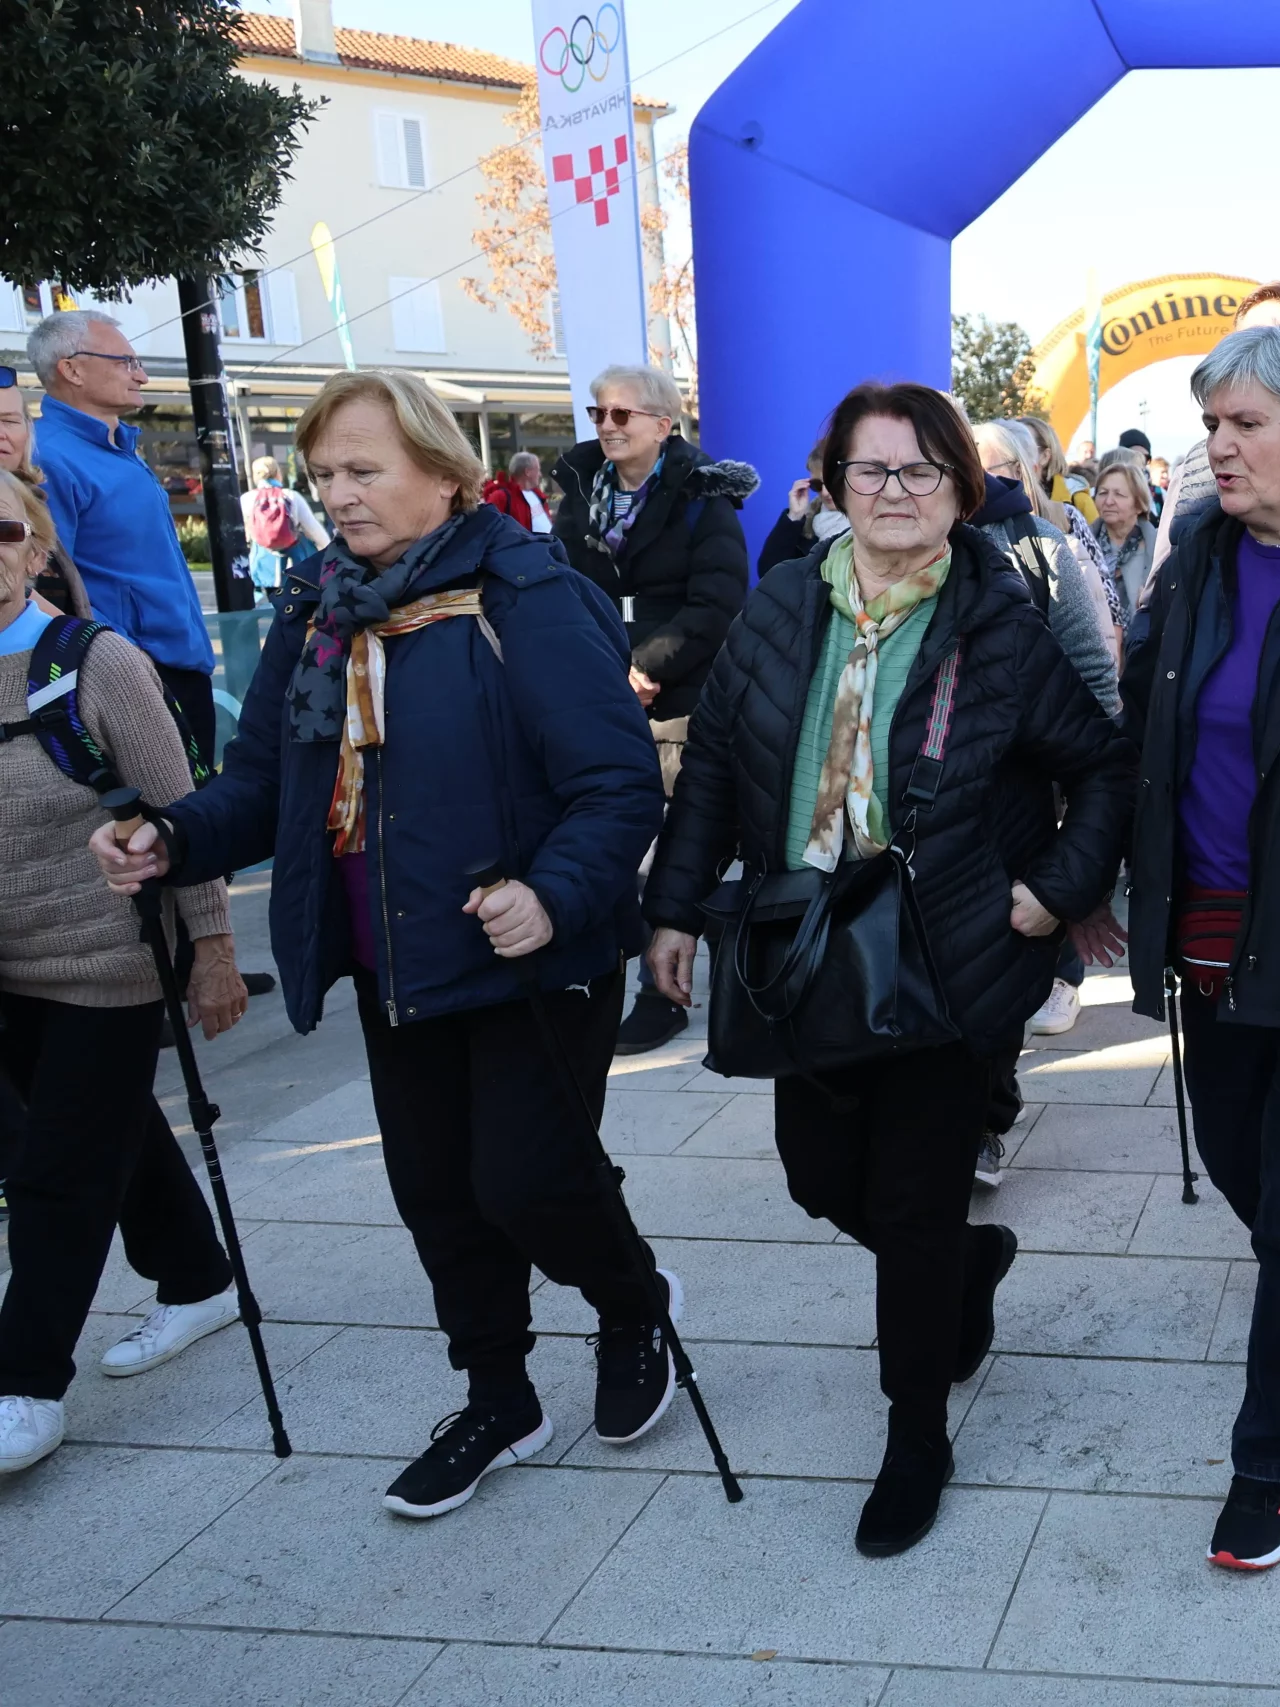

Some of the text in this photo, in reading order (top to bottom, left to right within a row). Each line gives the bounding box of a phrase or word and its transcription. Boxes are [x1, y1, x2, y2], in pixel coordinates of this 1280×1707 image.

[1101, 292, 1241, 355] Contine
[1149, 324, 1230, 348] The Future
